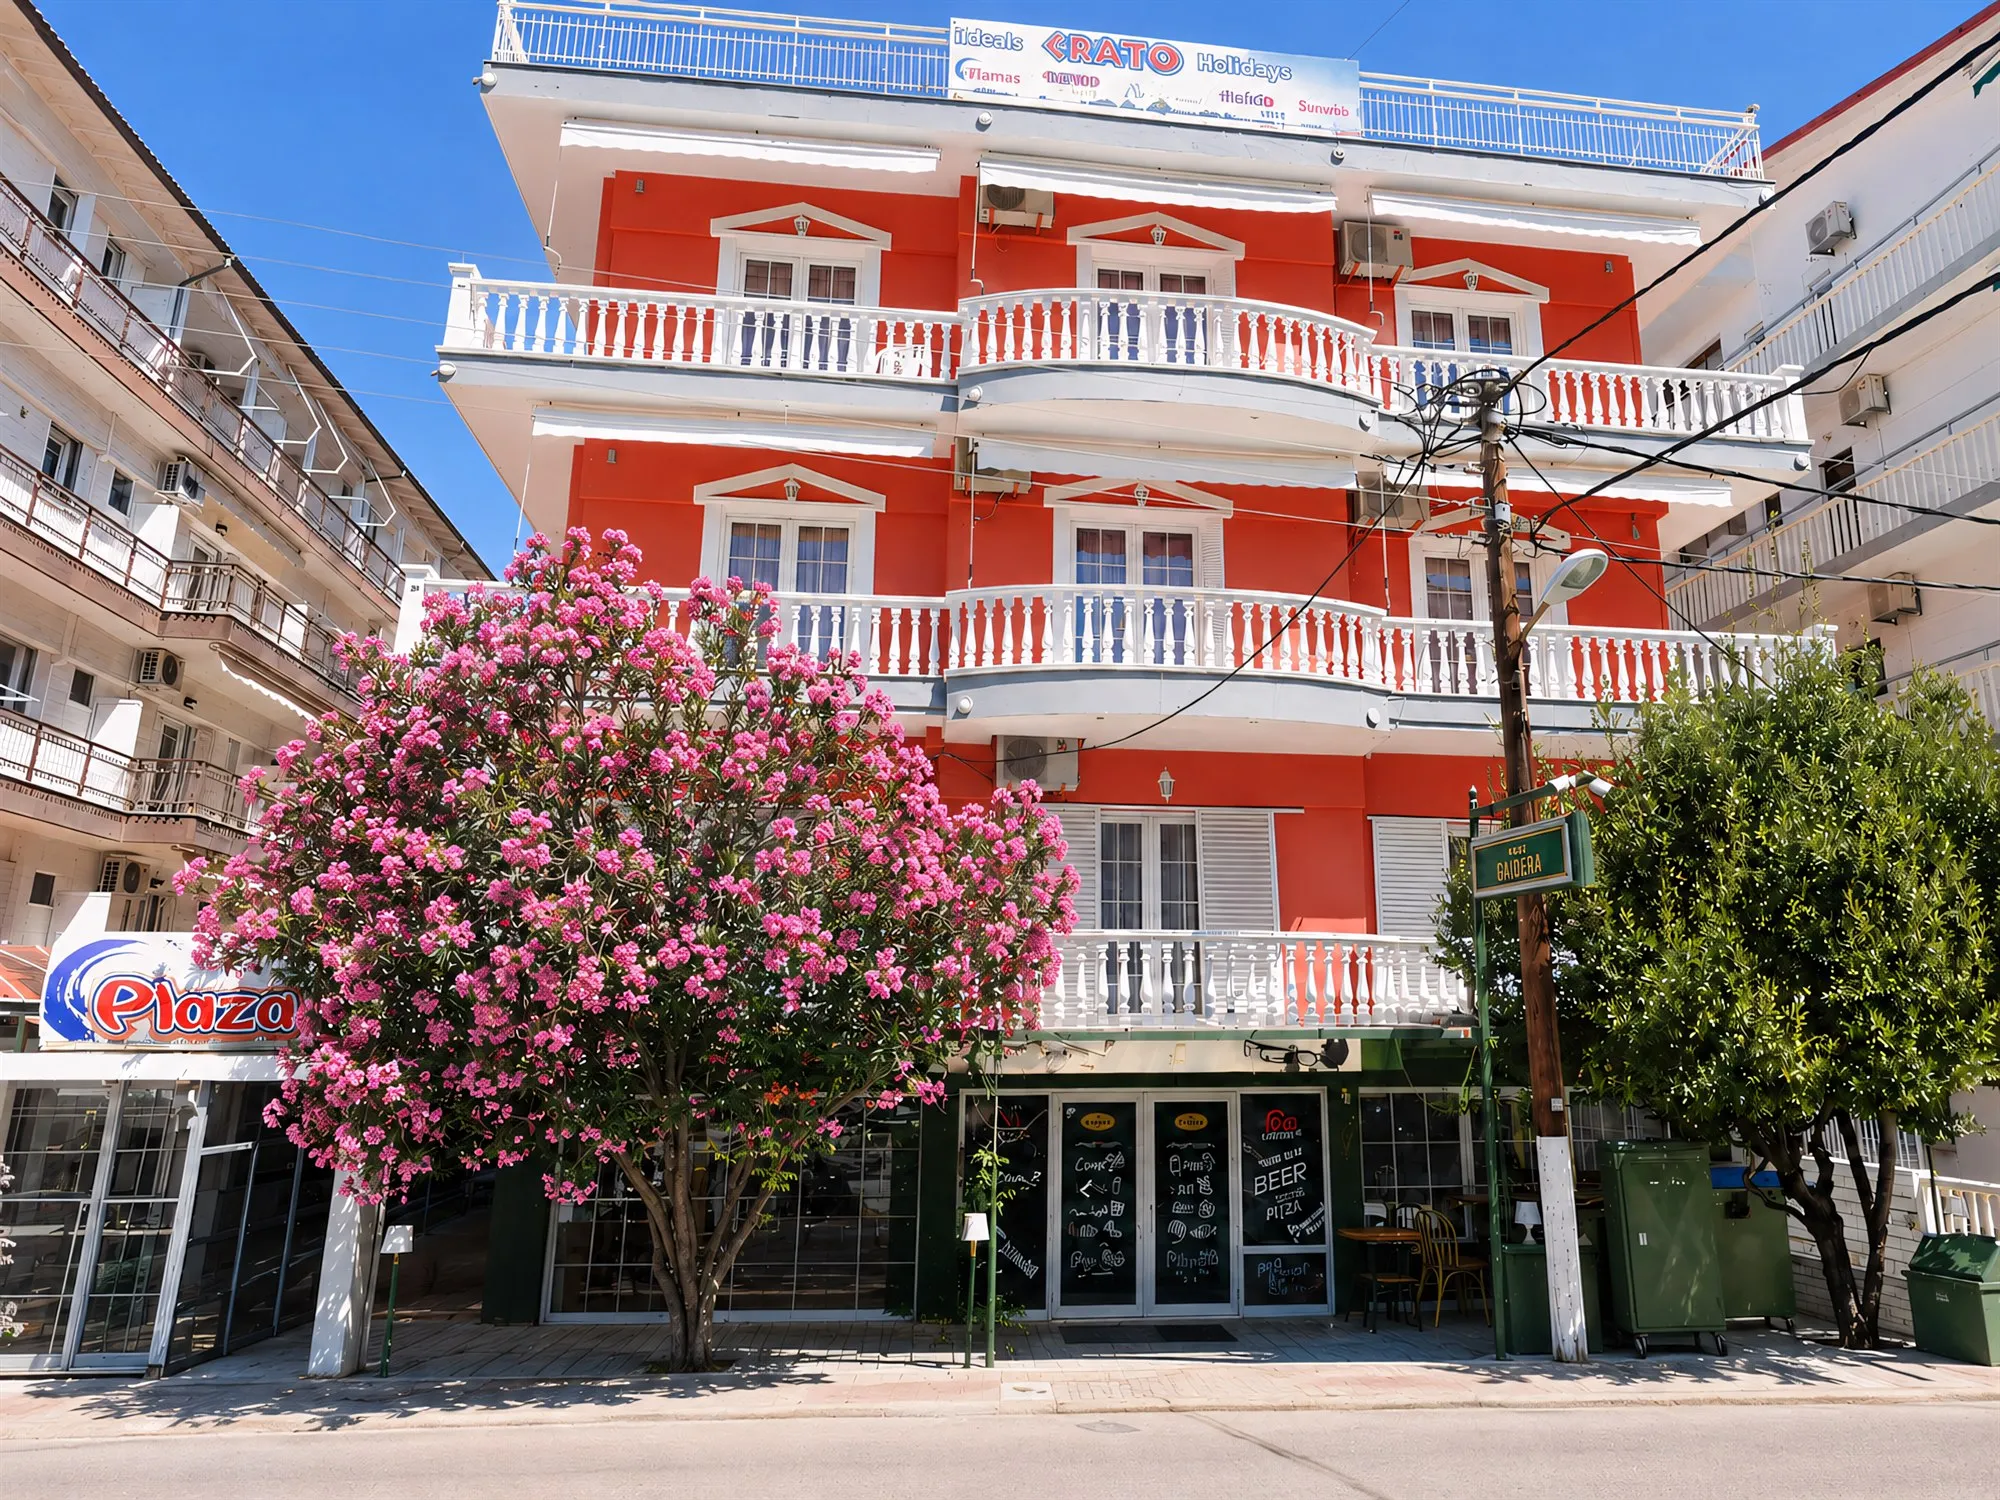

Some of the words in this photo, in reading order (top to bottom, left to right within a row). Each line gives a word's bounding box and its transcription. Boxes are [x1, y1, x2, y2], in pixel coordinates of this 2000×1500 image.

[1197, 52, 1293, 83] Holidays
[93, 974, 298, 1036] Plaza
[1254, 1162, 1307, 1196] BEER
